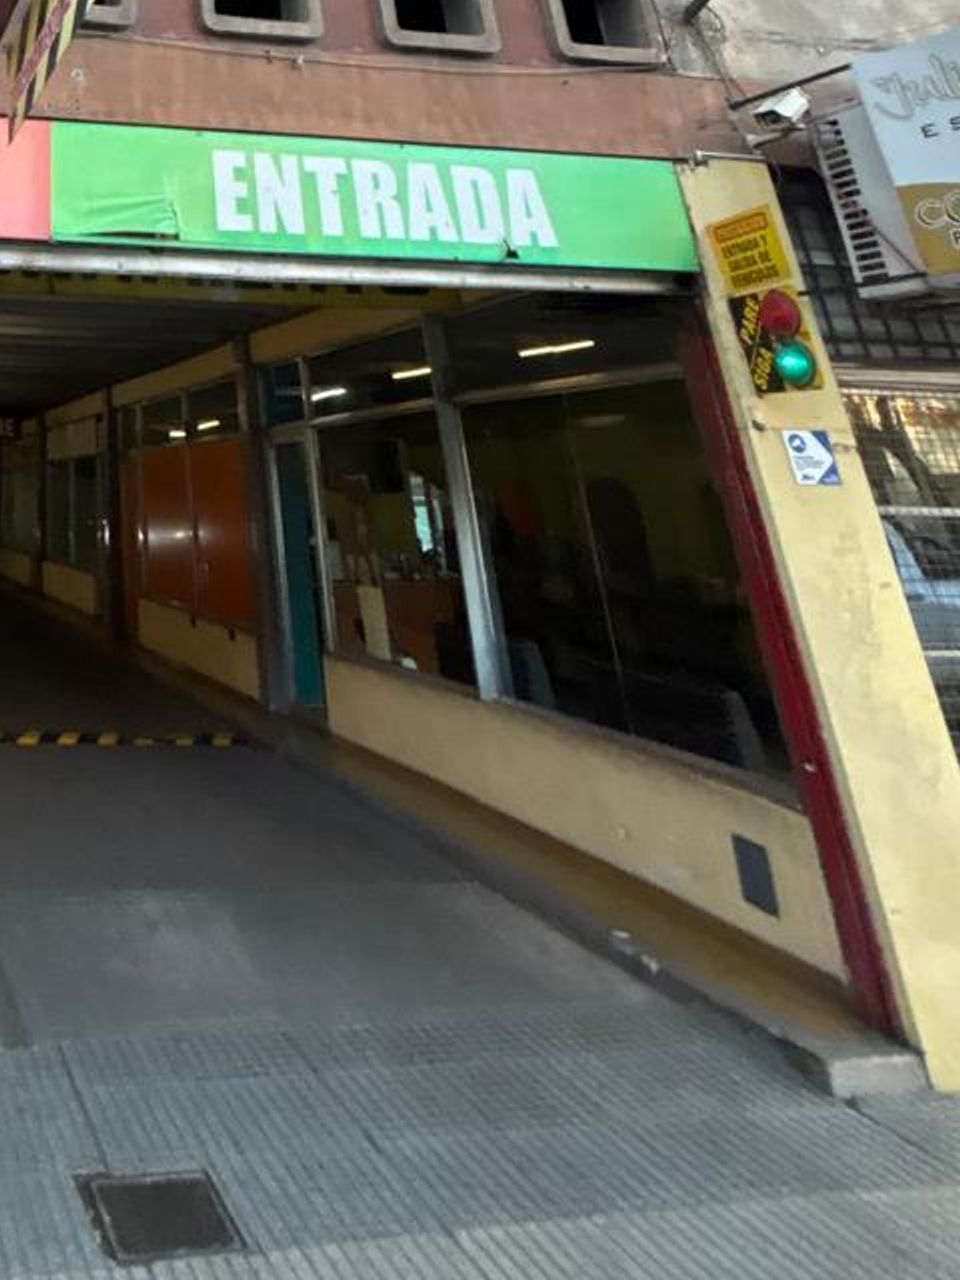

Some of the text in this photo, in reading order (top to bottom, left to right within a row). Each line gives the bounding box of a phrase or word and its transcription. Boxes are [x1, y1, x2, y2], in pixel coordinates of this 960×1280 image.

[212, 148, 558, 249] ENTRADA
[740, 295, 760, 346] PARE
[753, 346, 772, 390] SIGA
